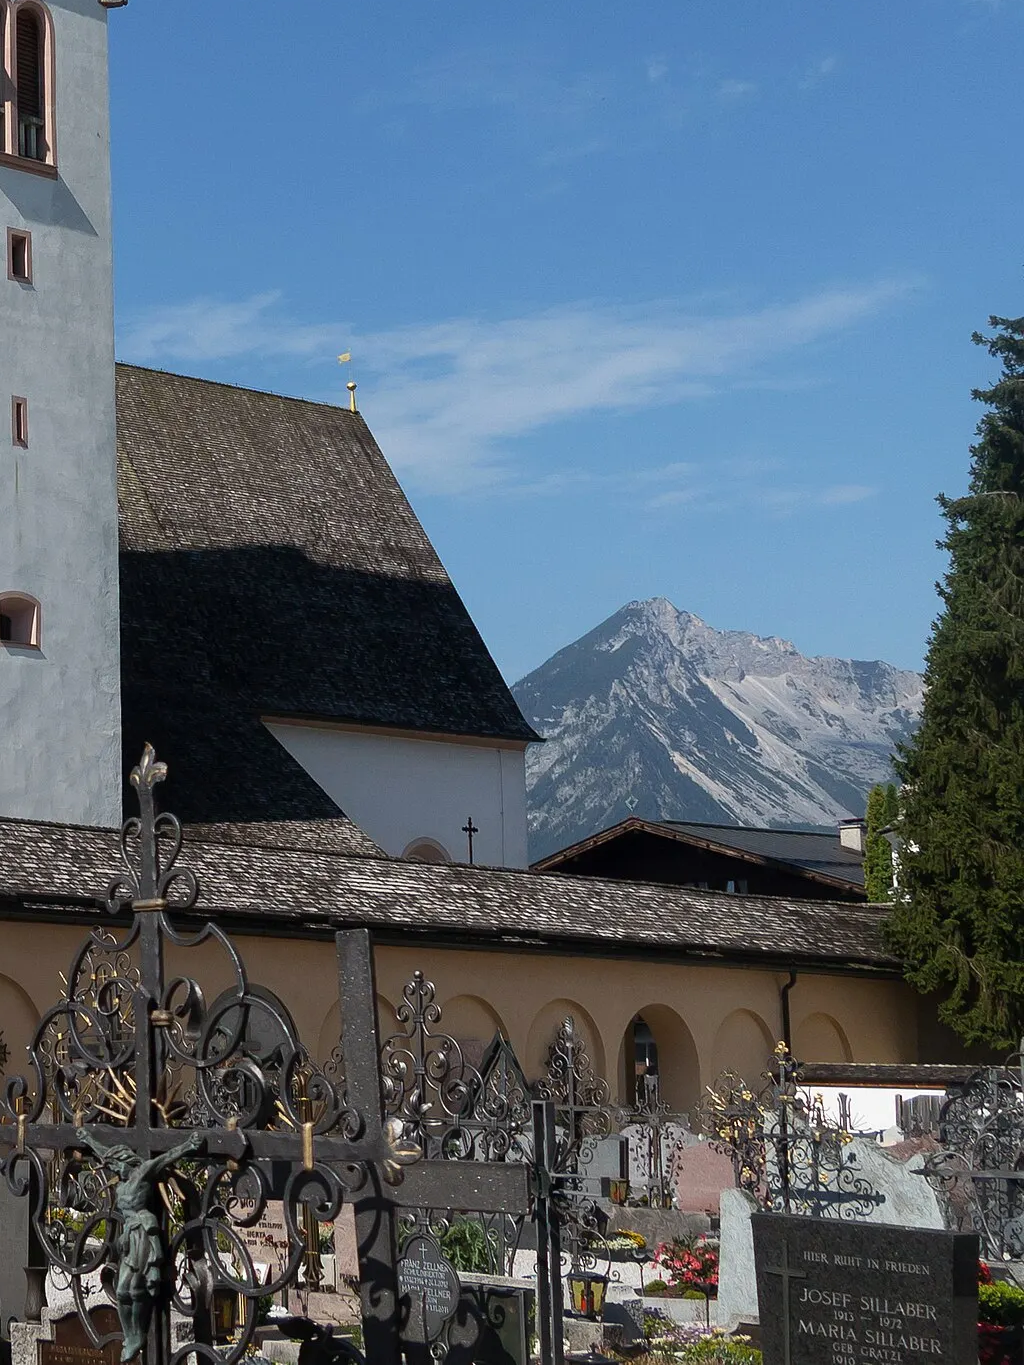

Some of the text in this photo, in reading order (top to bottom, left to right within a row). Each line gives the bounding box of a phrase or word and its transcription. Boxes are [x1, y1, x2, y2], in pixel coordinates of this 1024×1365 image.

[803, 1251, 931, 1275] HIER RUHT IN FRIEDEN
[799, 1288, 937, 1321] JOSEF SILLABER
[834, 1310, 855, 1322] 1913
[879, 1317, 903, 1329] 1972
[798, 1319, 943, 1354] MARIA SILLABER
